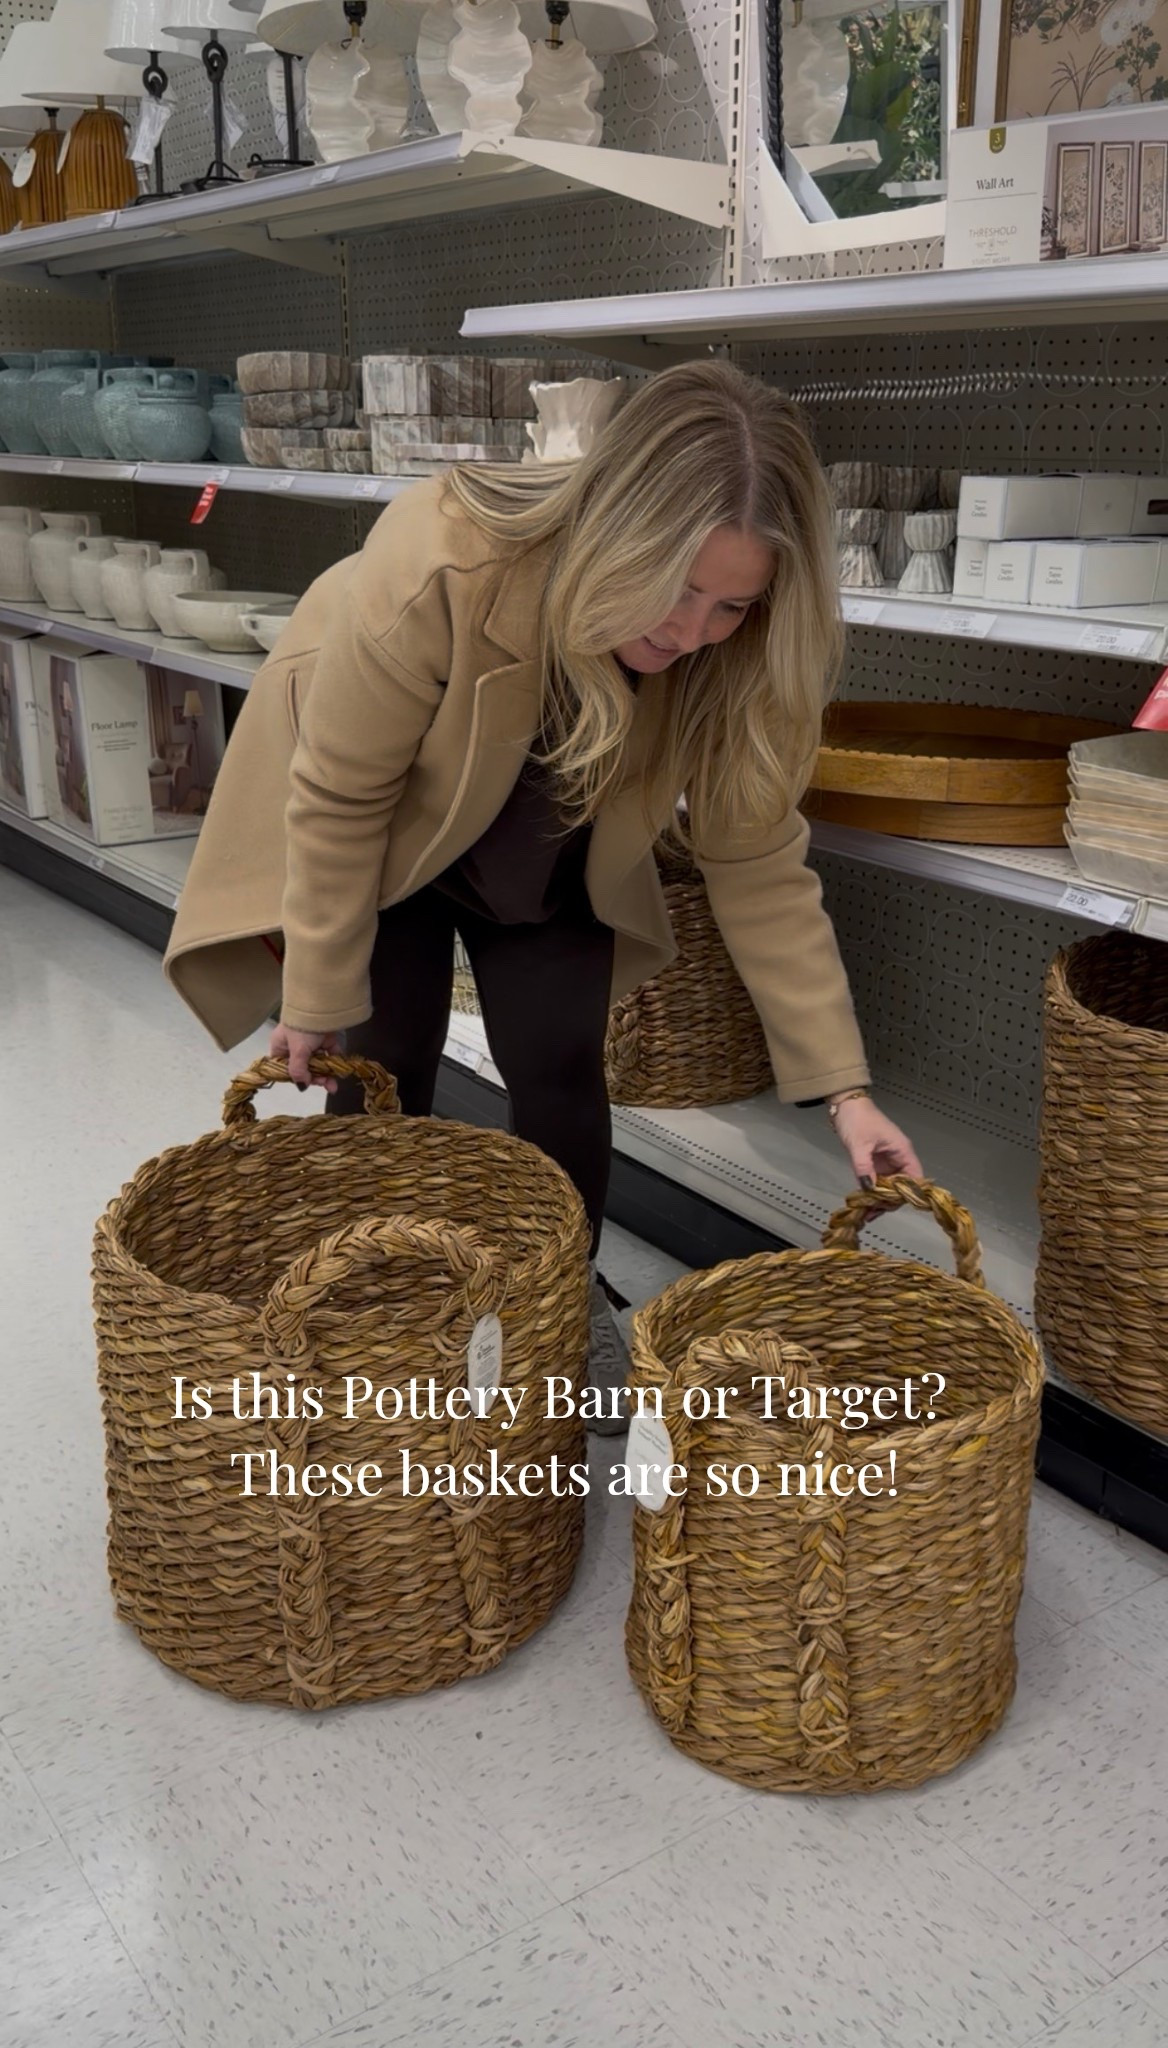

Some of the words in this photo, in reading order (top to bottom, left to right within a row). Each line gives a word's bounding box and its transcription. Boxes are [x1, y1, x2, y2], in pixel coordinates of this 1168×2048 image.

[994, 133, 1001, 144] 3
[976, 178, 997, 190] Wall
[998, 178, 1014, 188] Art
[969, 225, 1017, 238] THRESHOLD
[91, 721, 113, 732] Floor
[114, 720, 138, 731] Lamp
